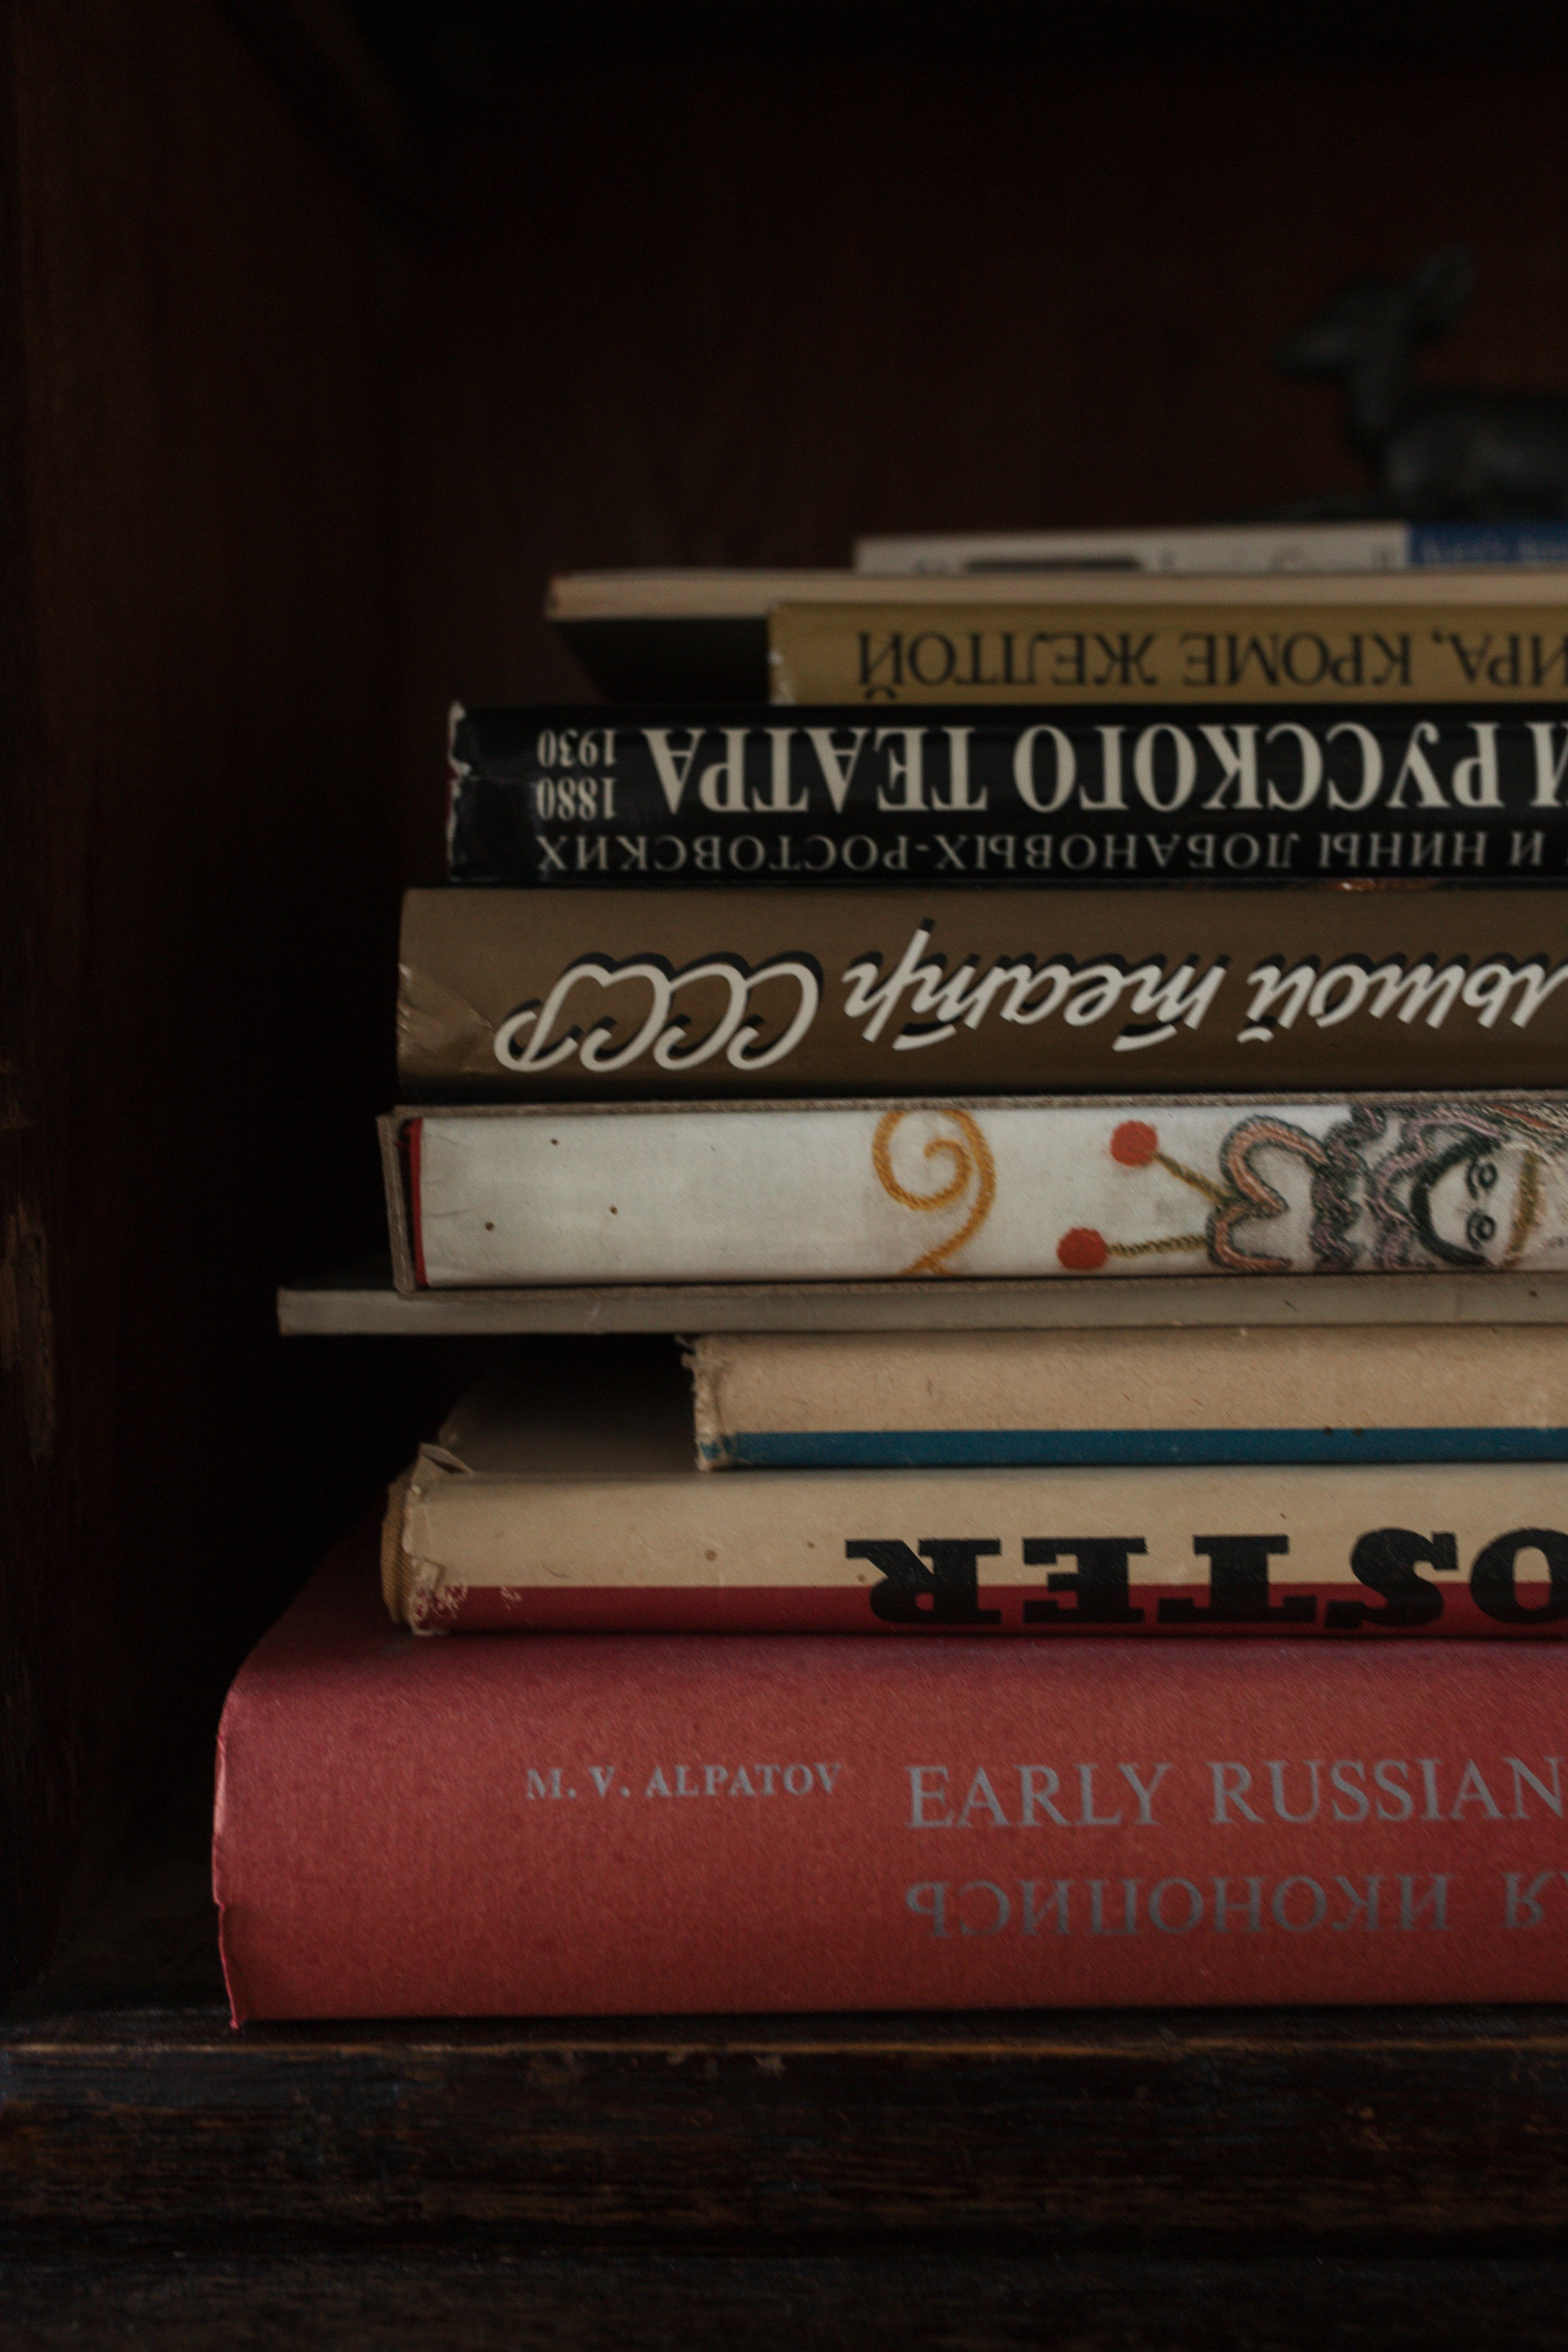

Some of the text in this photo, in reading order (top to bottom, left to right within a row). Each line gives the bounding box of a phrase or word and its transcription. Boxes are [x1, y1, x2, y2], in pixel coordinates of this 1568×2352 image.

[858, 631, 1157, 703] ЖЕЛТОЙ
[1180, 631, 1412, 687] КРОМЕ
[537, 730, 614, 767] 1930
[641, 726, 987, 815] ТЕАТРА
[1014, 722, 1505, 812] РУССКОГО
[535, 777, 614, 821] 1880
[536, 829, 1546, 872] И НИНЫ ЛОБАНОВЫХ-РОСТОВСКИХ
[494, 962, 821, 1072] СССР
[842, 927, 1227, 1052] театр
[526, 1763, 843, 1800] M. V. ALPATOV
[904, 1755, 1566, 1829] EARLY RUSSIAN
[905, 1872, 1457, 1939] ИКОНОПИСЬ
